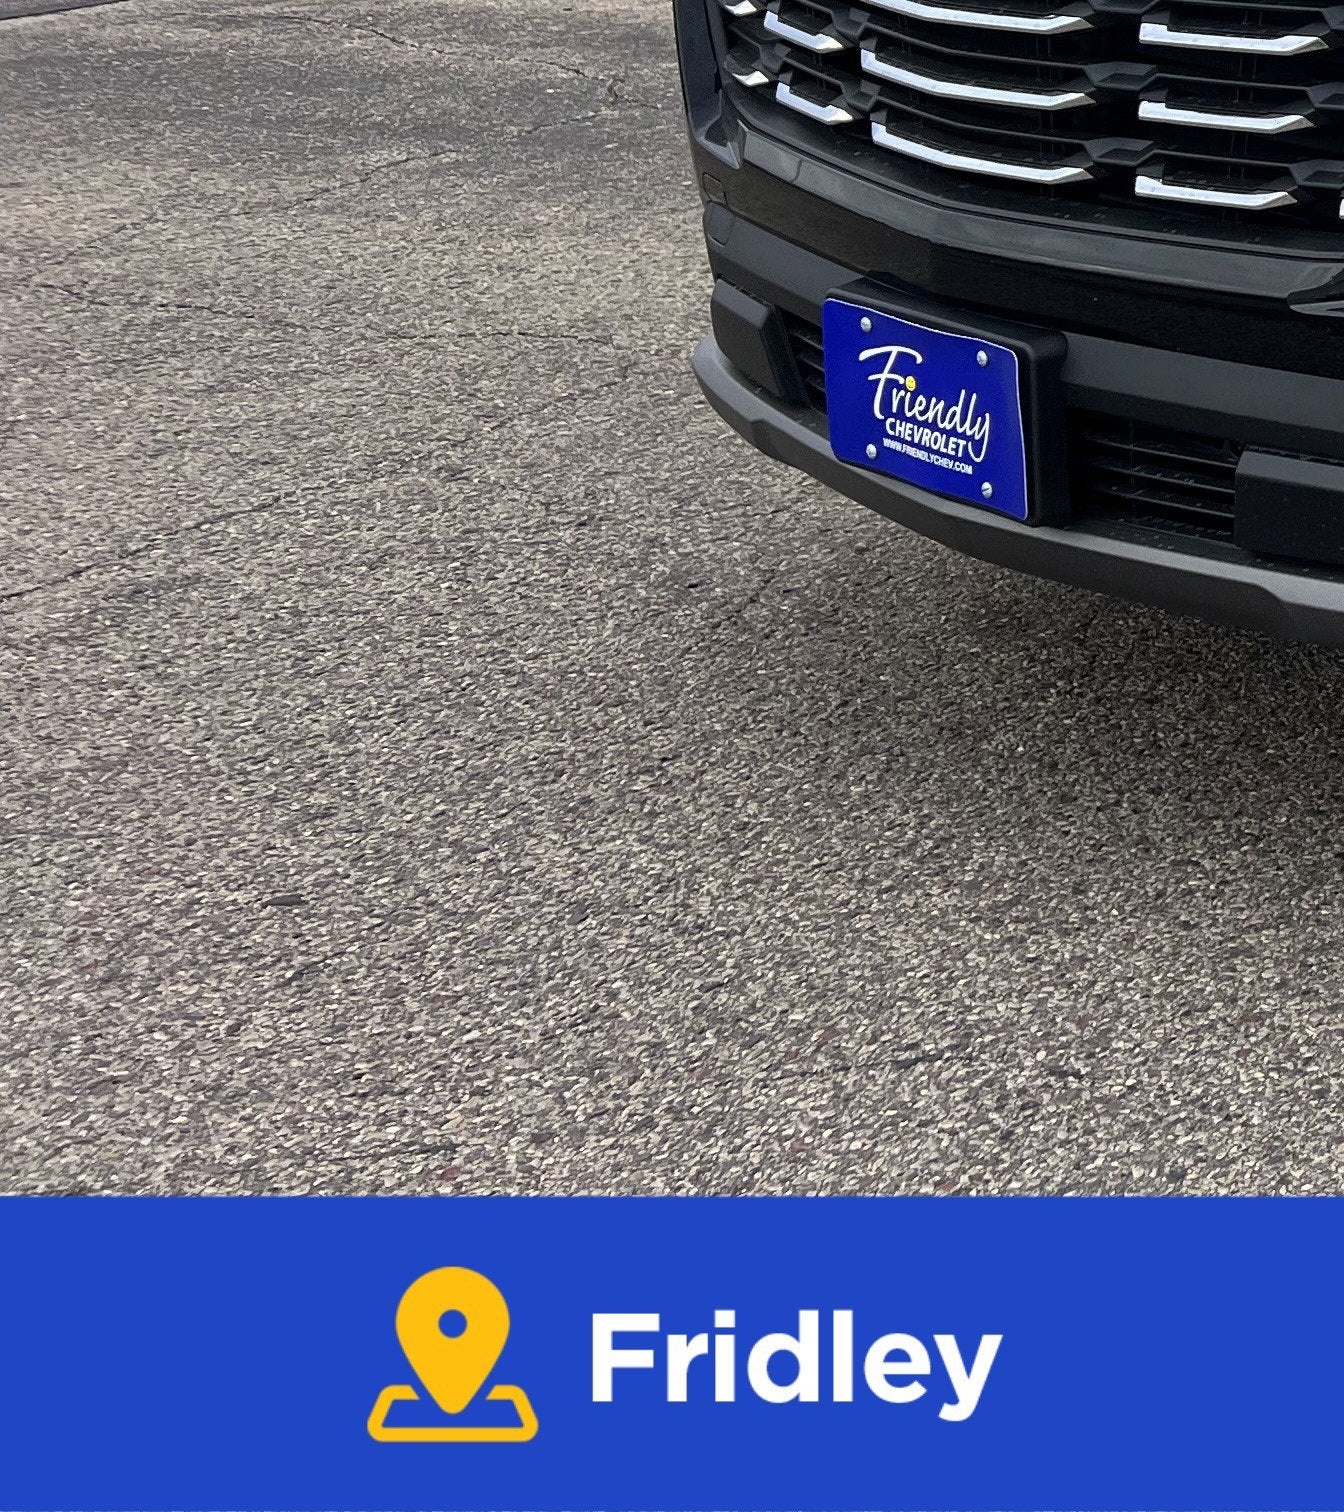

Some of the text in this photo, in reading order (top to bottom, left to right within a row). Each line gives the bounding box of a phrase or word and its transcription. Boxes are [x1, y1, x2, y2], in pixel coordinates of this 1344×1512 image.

[858, 345, 990, 463] Friendly
[883, 437, 973, 475] WWW.FRIENDLYCHEV.COM
[885, 417, 967, 458] CHEVROLET
